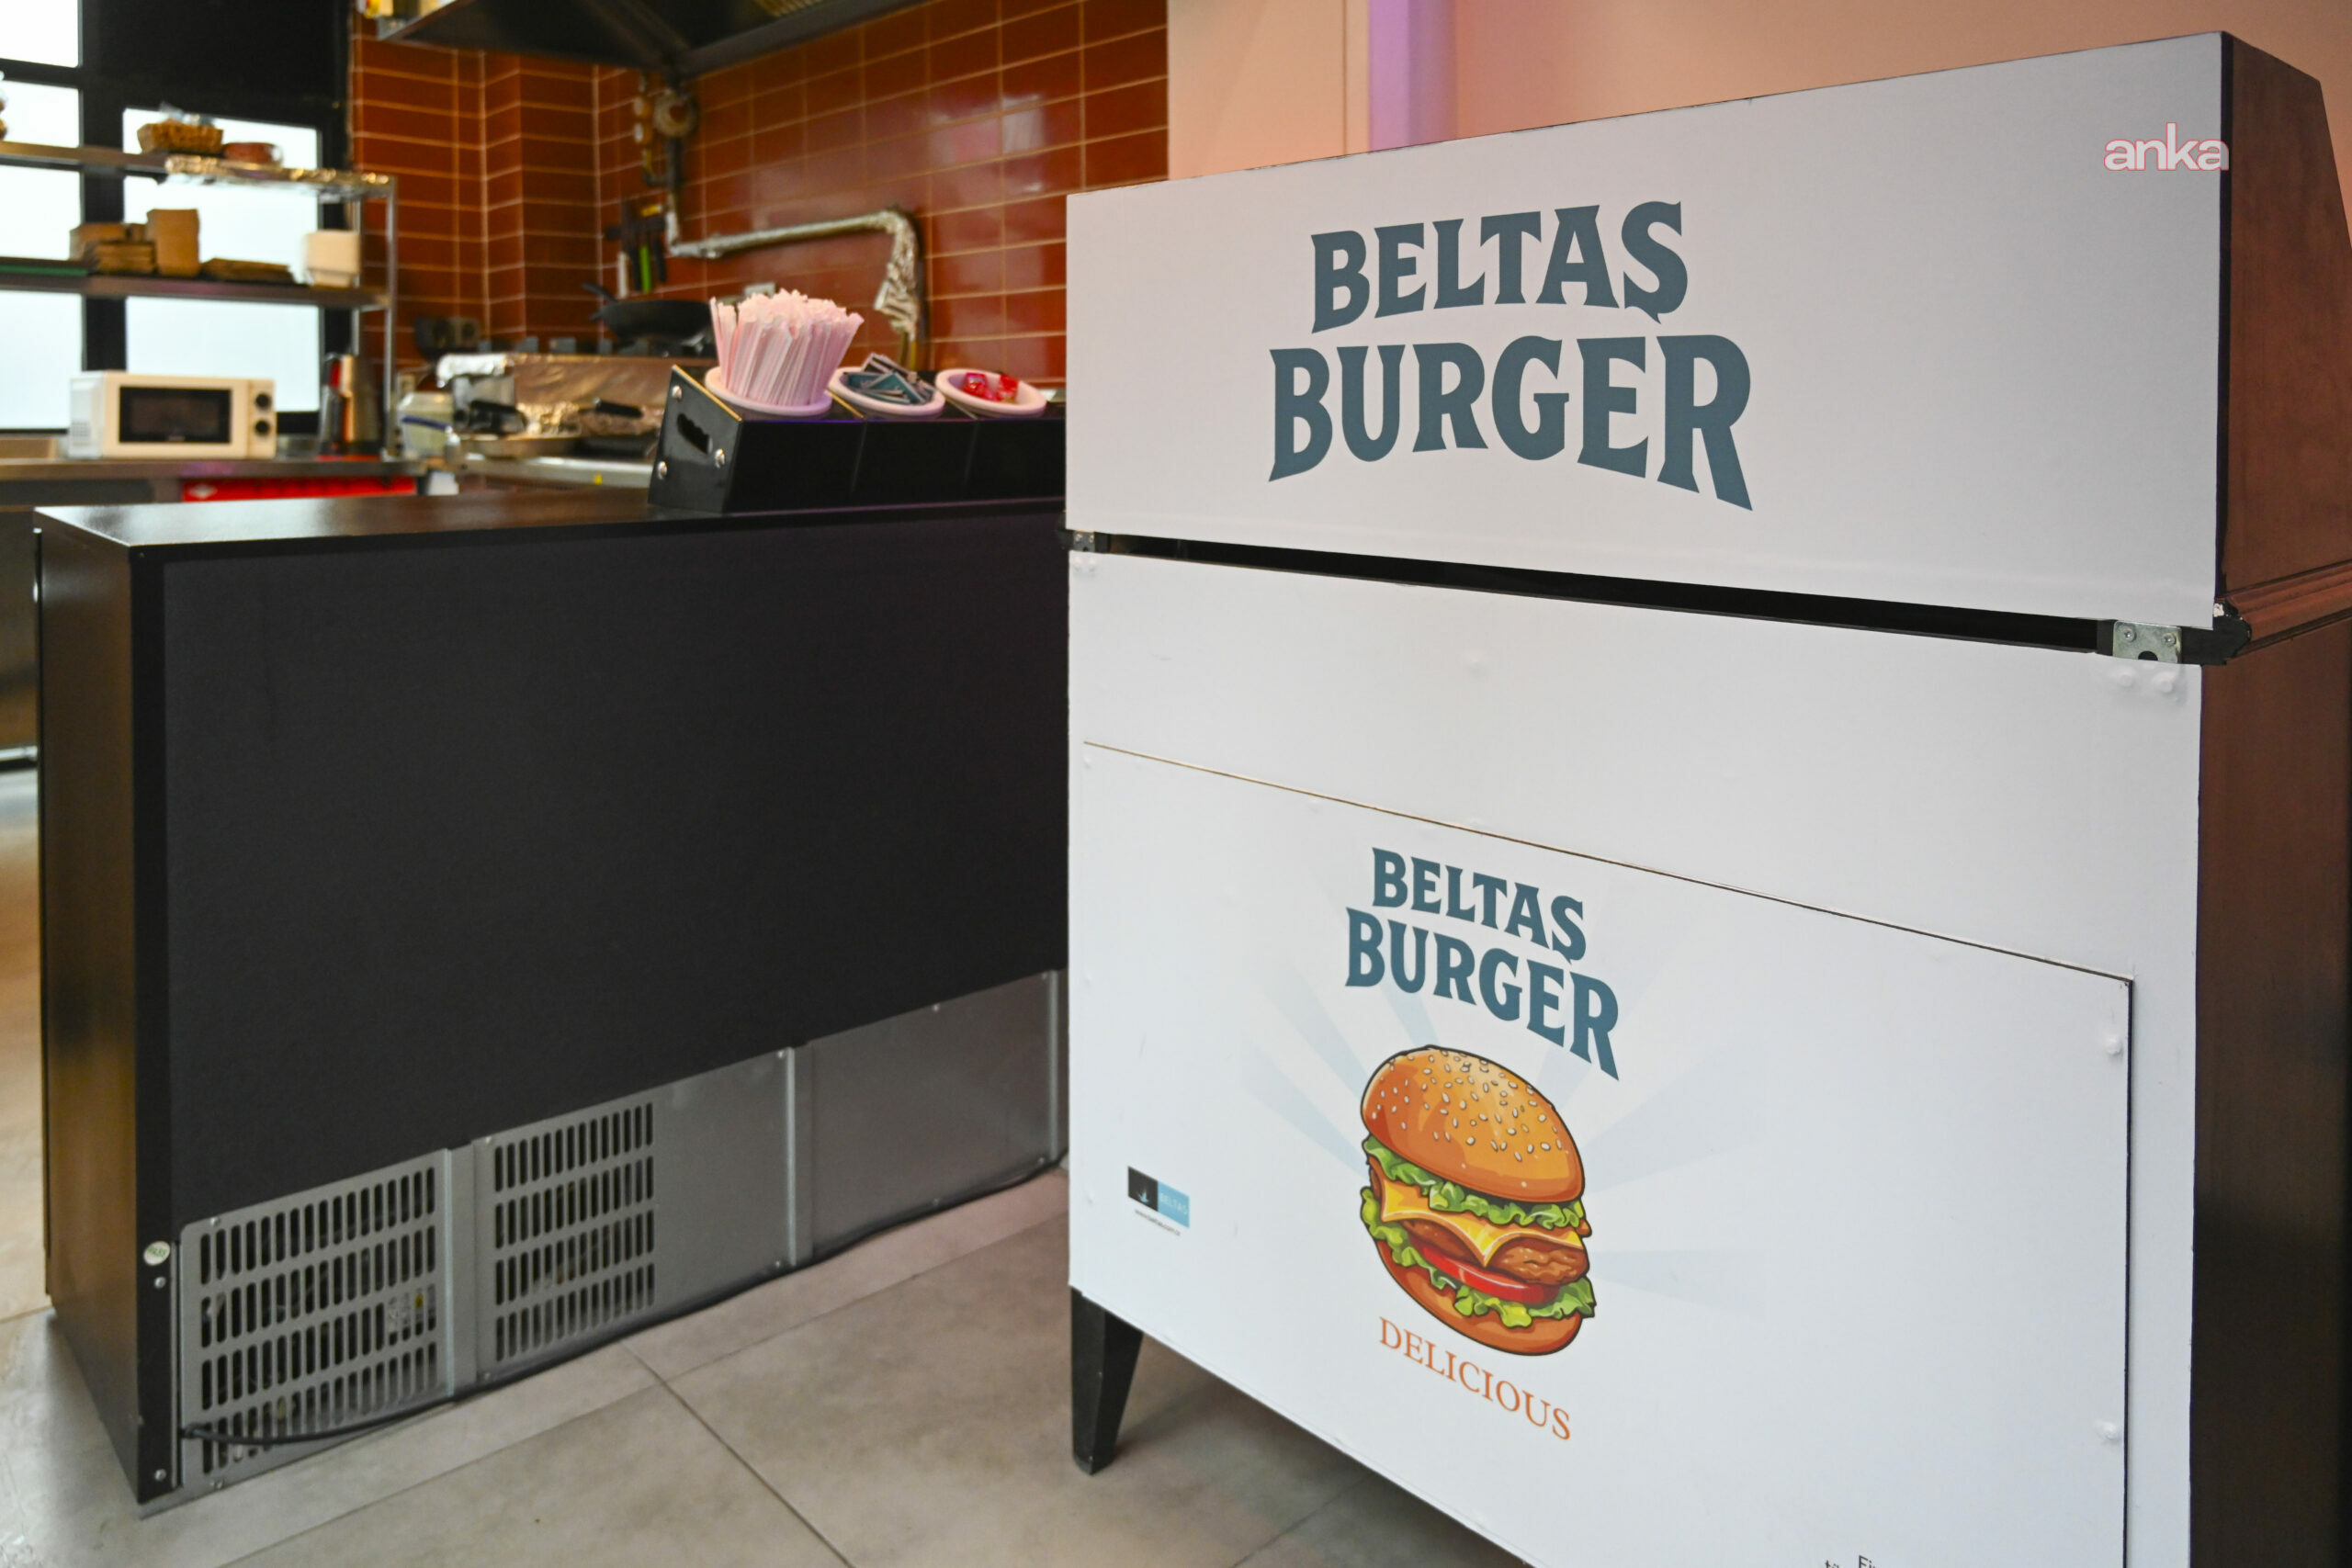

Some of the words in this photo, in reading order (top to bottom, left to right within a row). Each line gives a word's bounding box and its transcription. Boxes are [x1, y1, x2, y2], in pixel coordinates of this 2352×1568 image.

[1269, 334, 1753, 512] BURGER
[1345, 907, 1620, 1081] BURGER
[1379, 1316, 1571, 1440] DELICIOUS
